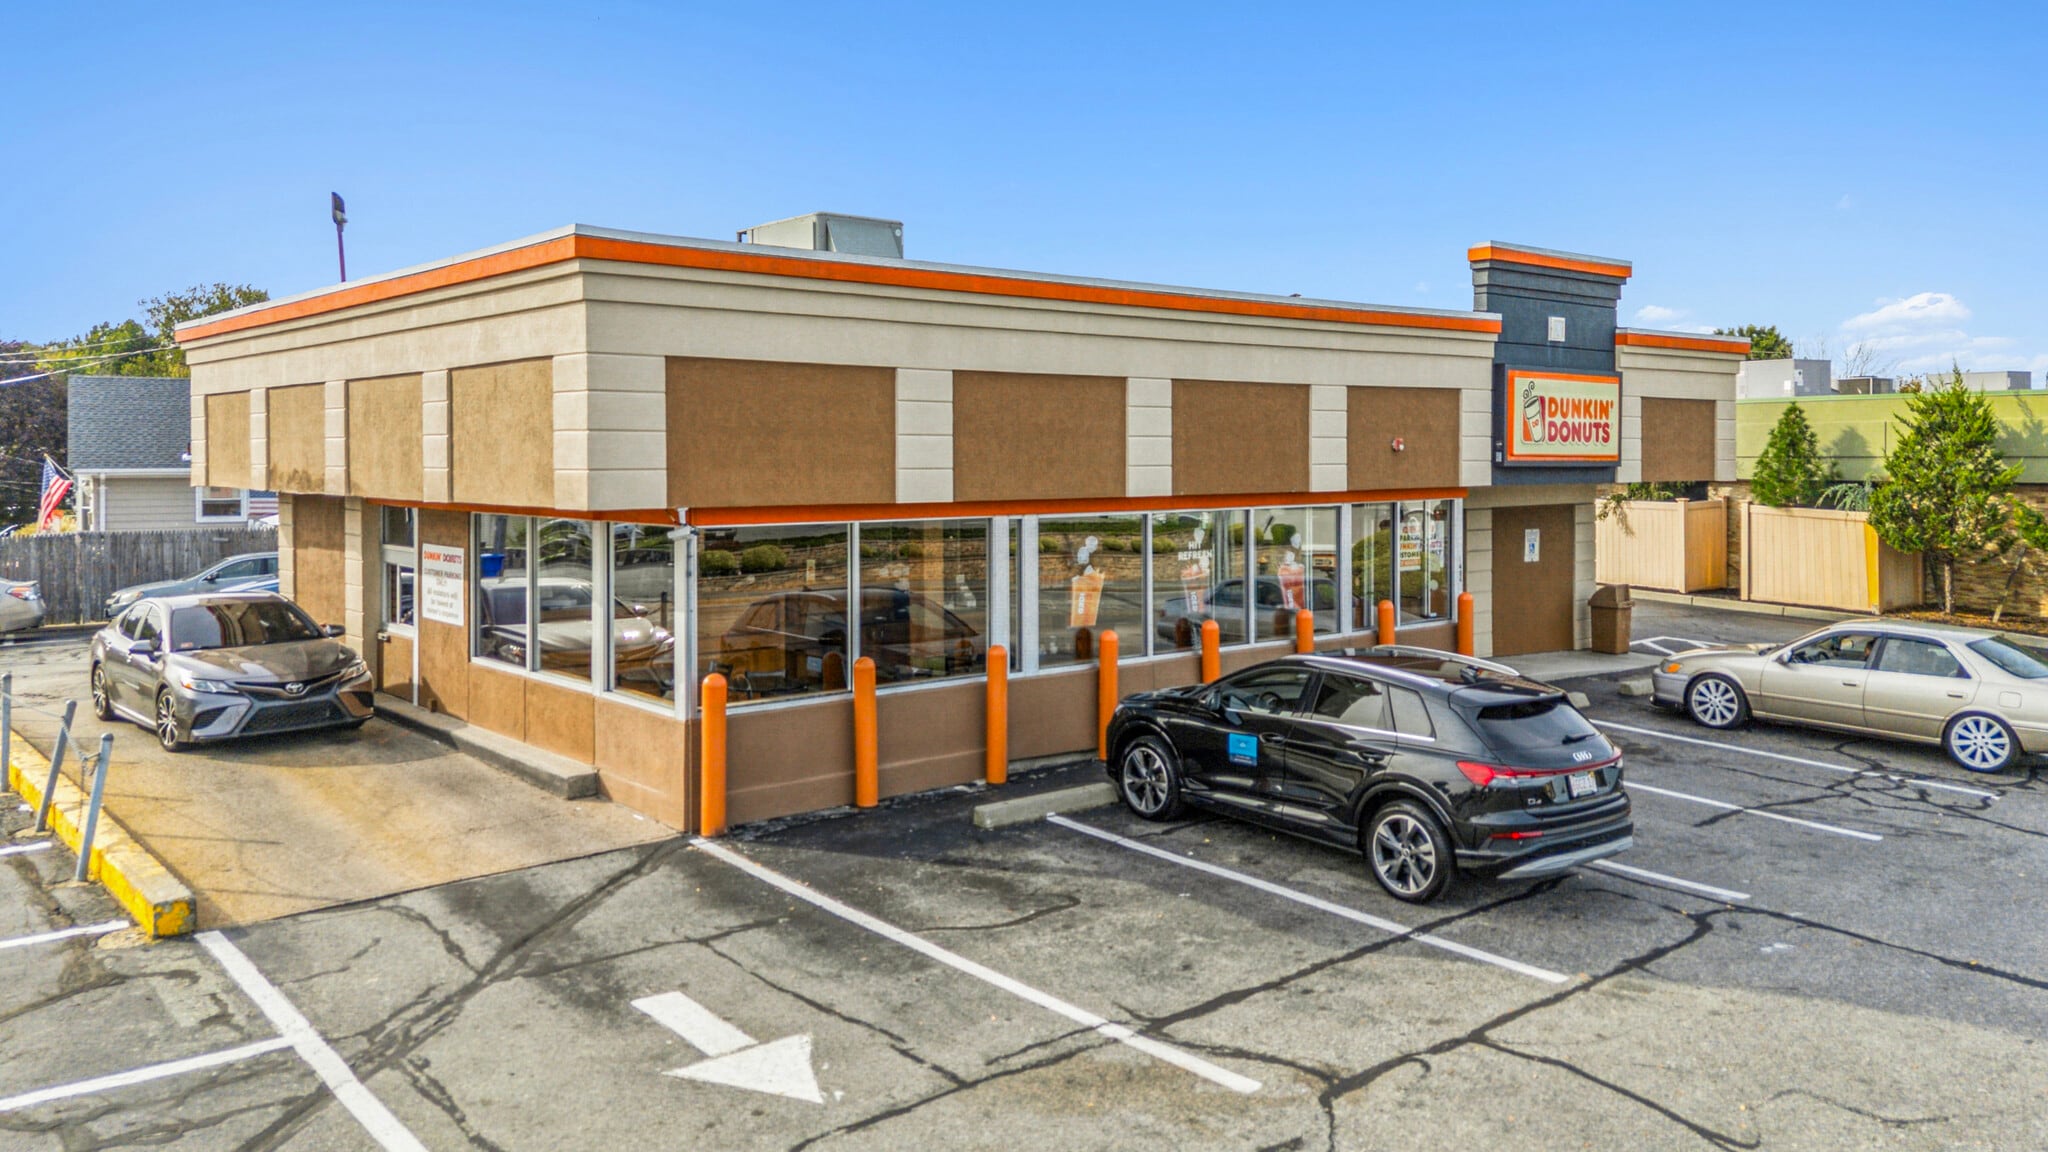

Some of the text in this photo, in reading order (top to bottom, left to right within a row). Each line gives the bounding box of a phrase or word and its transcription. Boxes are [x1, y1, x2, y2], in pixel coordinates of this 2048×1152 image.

[1548, 396, 1614, 420] DUNKIN'
[1548, 421, 1610, 443] DONUTS
[1178, 549, 1213, 560] REFRESH
[1188, 541, 1201, 550] HIT
[1077, 592, 1086, 615] ICED
